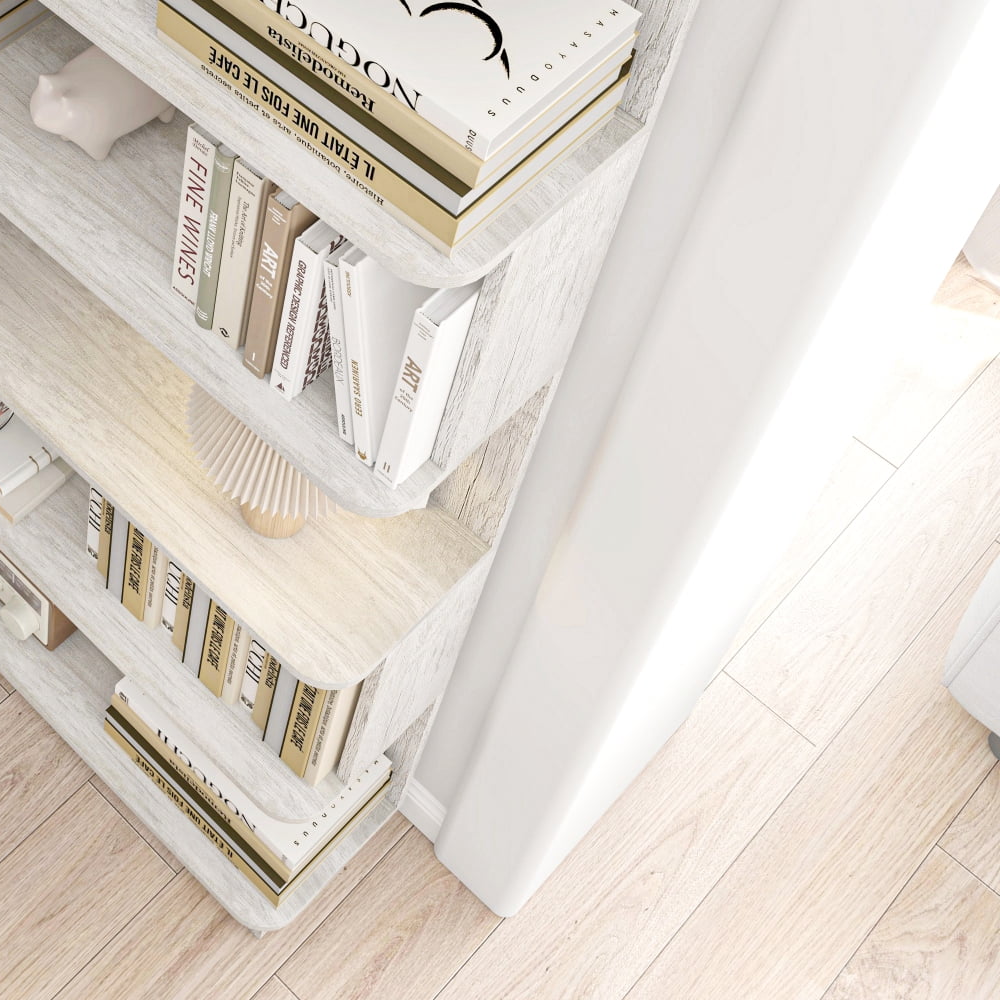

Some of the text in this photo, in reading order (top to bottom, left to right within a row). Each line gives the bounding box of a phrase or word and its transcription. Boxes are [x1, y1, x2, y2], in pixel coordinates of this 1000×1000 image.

[199, 64, 234, 91] secrets
[266, 26, 377, 114] Remodelista
[205, 46, 375, 182] IL ÉTAIT UNE FOIS LE CAFÉ
[464, 129, 477, 152] DUUS
[341, 170, 385, 206] Histoire,
[178, 156, 207, 286] FINE WINES
[260, 241, 279, 279] ART
[294, 260, 307, 297] GRAPHIC
[287, 295, 301, 324] DESIGN
[280, 321, 297, 370] REFERENCED
[401, 355, 424, 394] ART
[350, 359, 363, 417] EERO SAARINEN
[132, 538, 143, 556] UNE
[130, 549, 143, 569] FOIS
[130, 565, 141, 577] LE
[213, 614, 226, 633] UNE
[210, 628, 224, 647] FOIS
[209, 643, 221, 656] LE
[299, 697, 313, 715] UNE
[295, 708, 310, 729] FOIS
[293, 723, 307, 739] LE
[155, 777, 167, 789] LE
[164, 786, 185, 807] FOIS
[182, 805, 202, 825] UNE
[223, 847, 235, 858] IL
